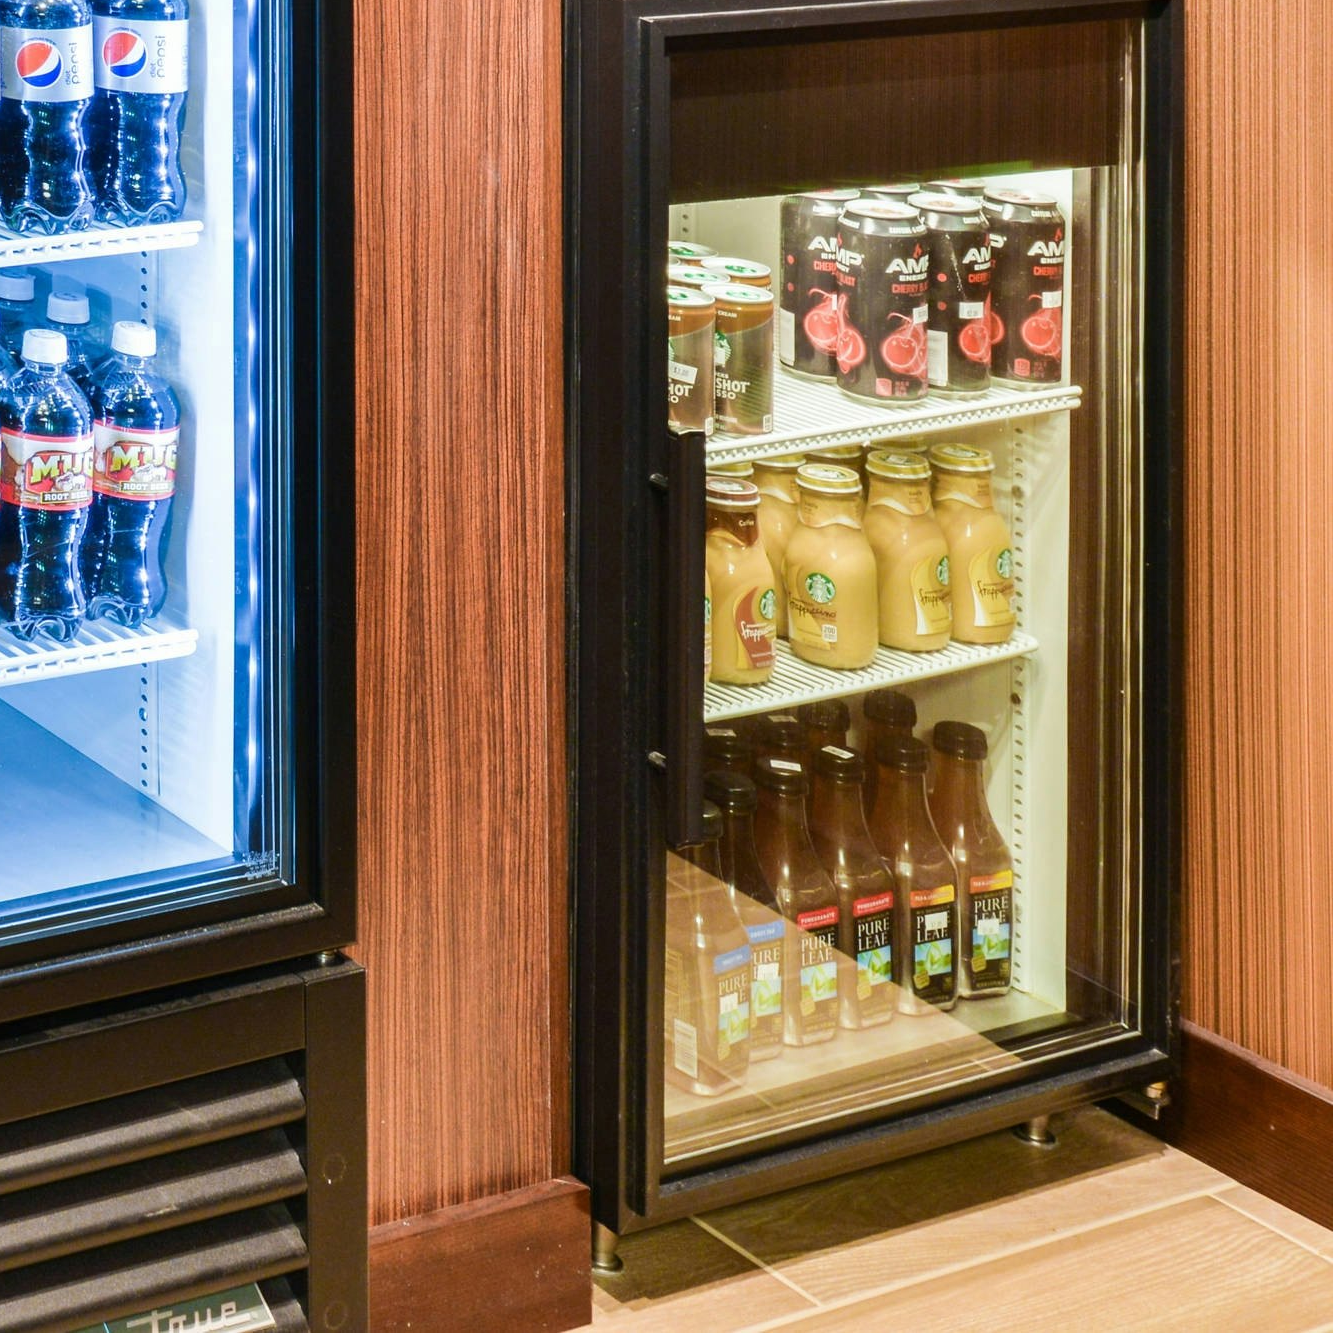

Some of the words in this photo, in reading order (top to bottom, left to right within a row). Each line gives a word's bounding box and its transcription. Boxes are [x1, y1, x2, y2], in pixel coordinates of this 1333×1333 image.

[112, 444, 176, 471] MUG
[30, 451, 93, 483] MUG
[856, 896, 891, 911] POMEGRANATE
[974, 896, 1009, 911] PURE
[858, 917, 890, 936] PURE
[917, 928, 947, 943] LEAF
[801, 933, 835, 952] PURE
[858, 934, 888, 951] LEAF
[801, 949, 833, 966] LEAF
[719, 976, 748, 995] PURE
